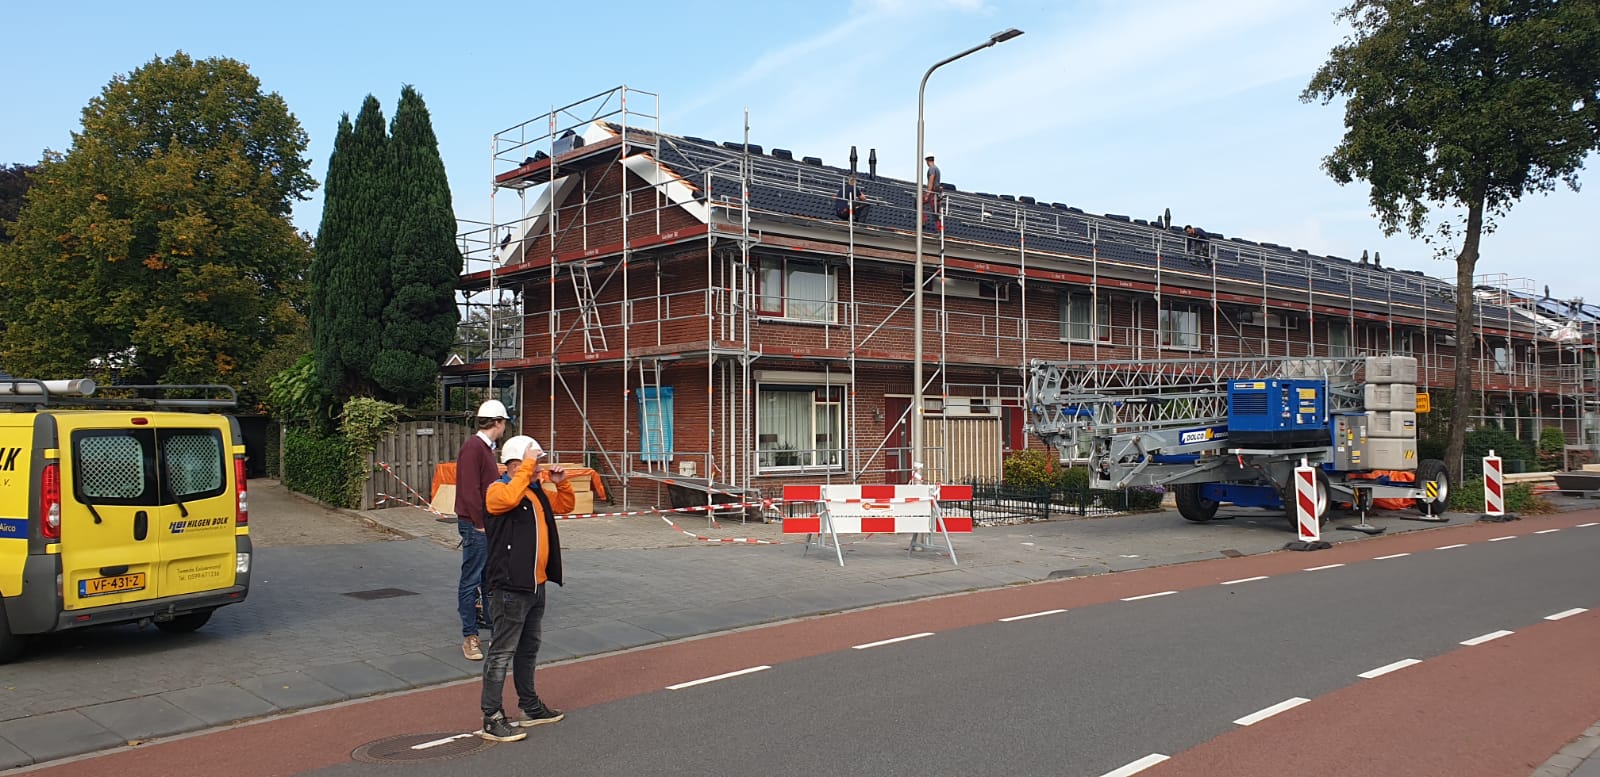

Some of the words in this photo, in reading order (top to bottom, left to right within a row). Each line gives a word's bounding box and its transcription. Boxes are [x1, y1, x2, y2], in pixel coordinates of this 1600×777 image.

[187, 519, 211, 528] HILGEN
[212, 517, 229, 525] BOLK
[93, 576, 139, 591] VF-431-Z
